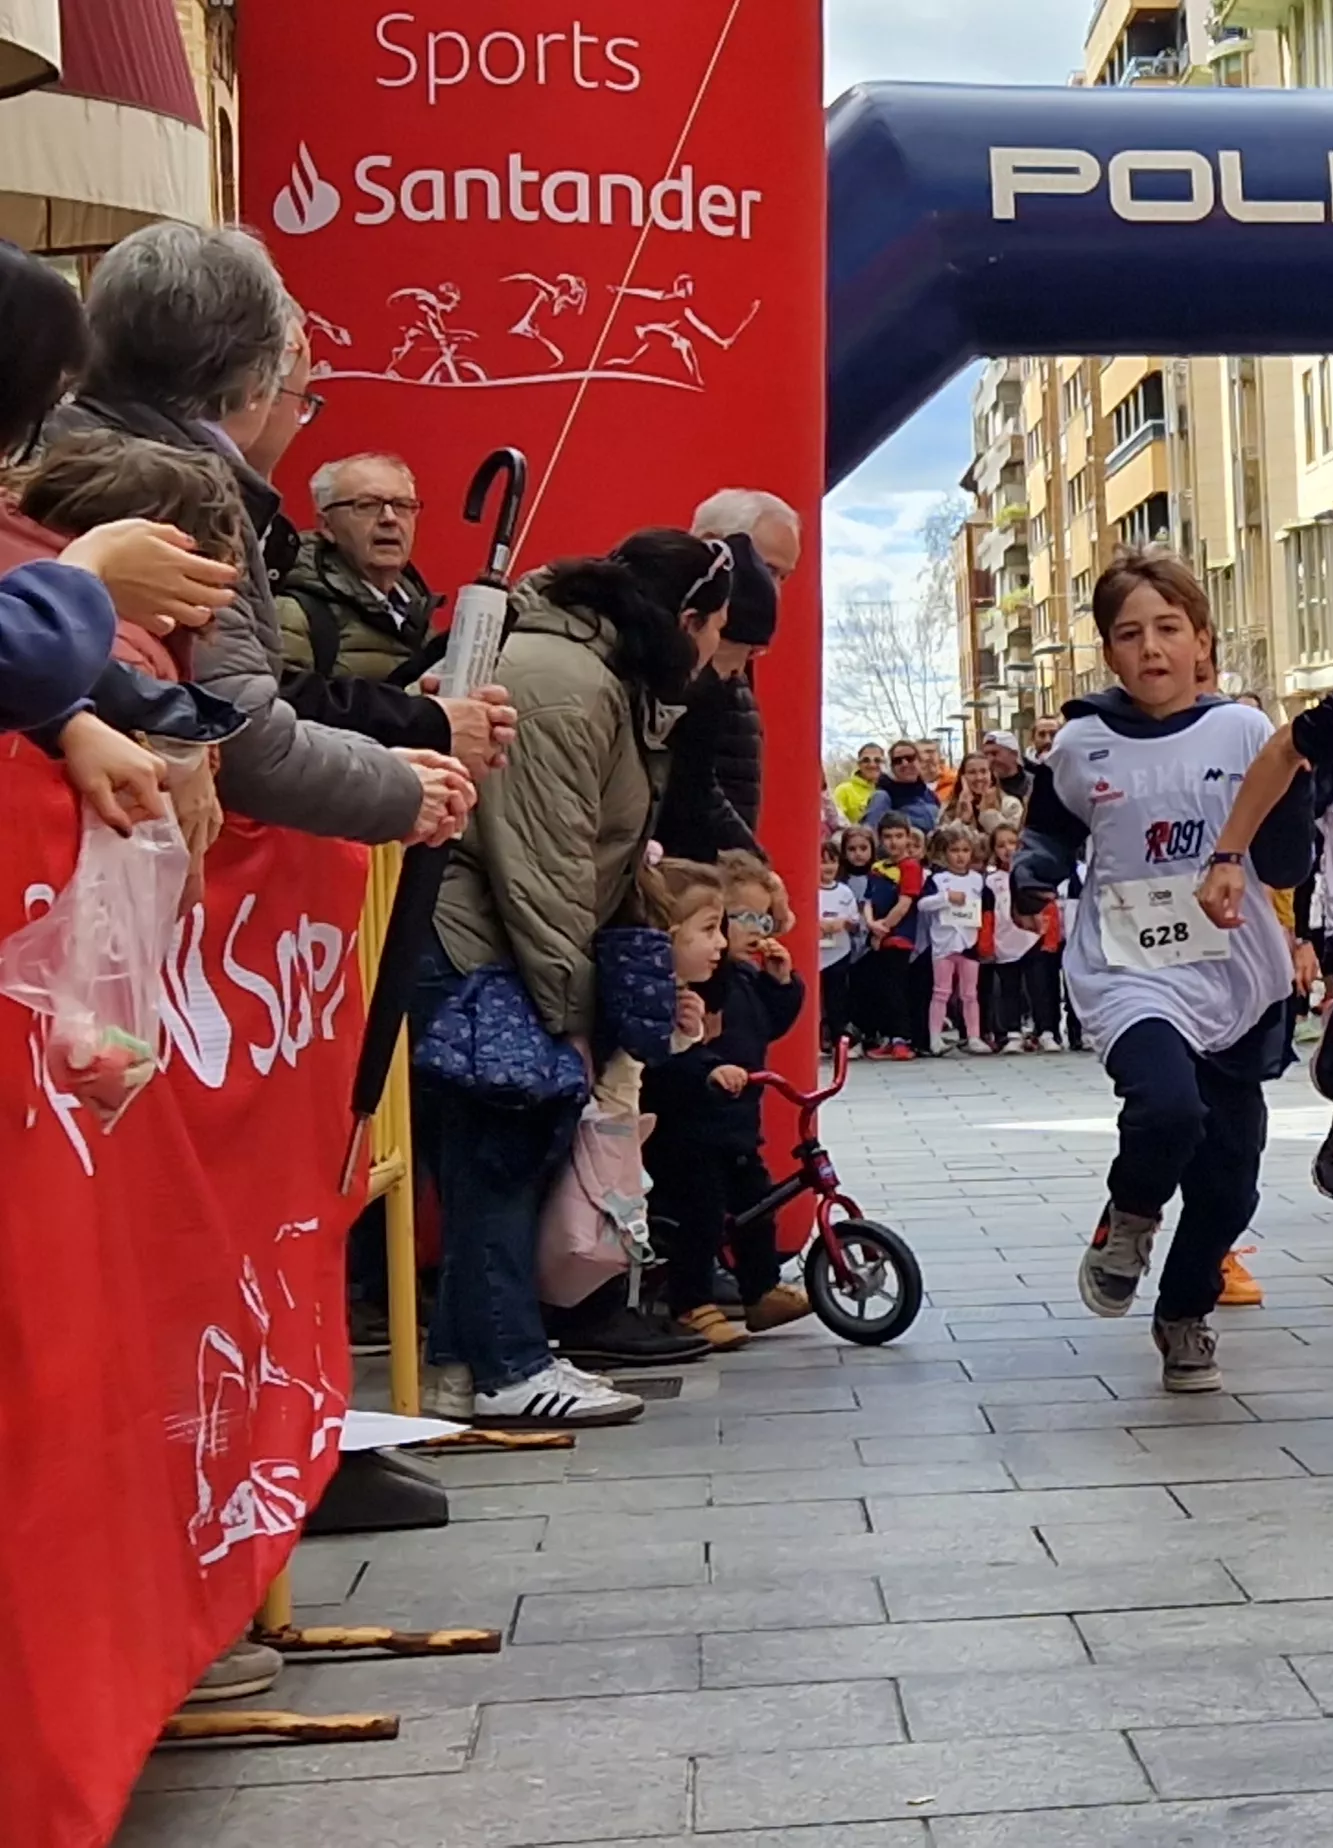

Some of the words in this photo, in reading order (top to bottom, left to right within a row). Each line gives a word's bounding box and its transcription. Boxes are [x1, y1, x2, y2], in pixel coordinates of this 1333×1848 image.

[376, 13, 641, 105] Sports
[353, 152, 763, 240] Santander
[1139, 921, 1190, 949] 628
